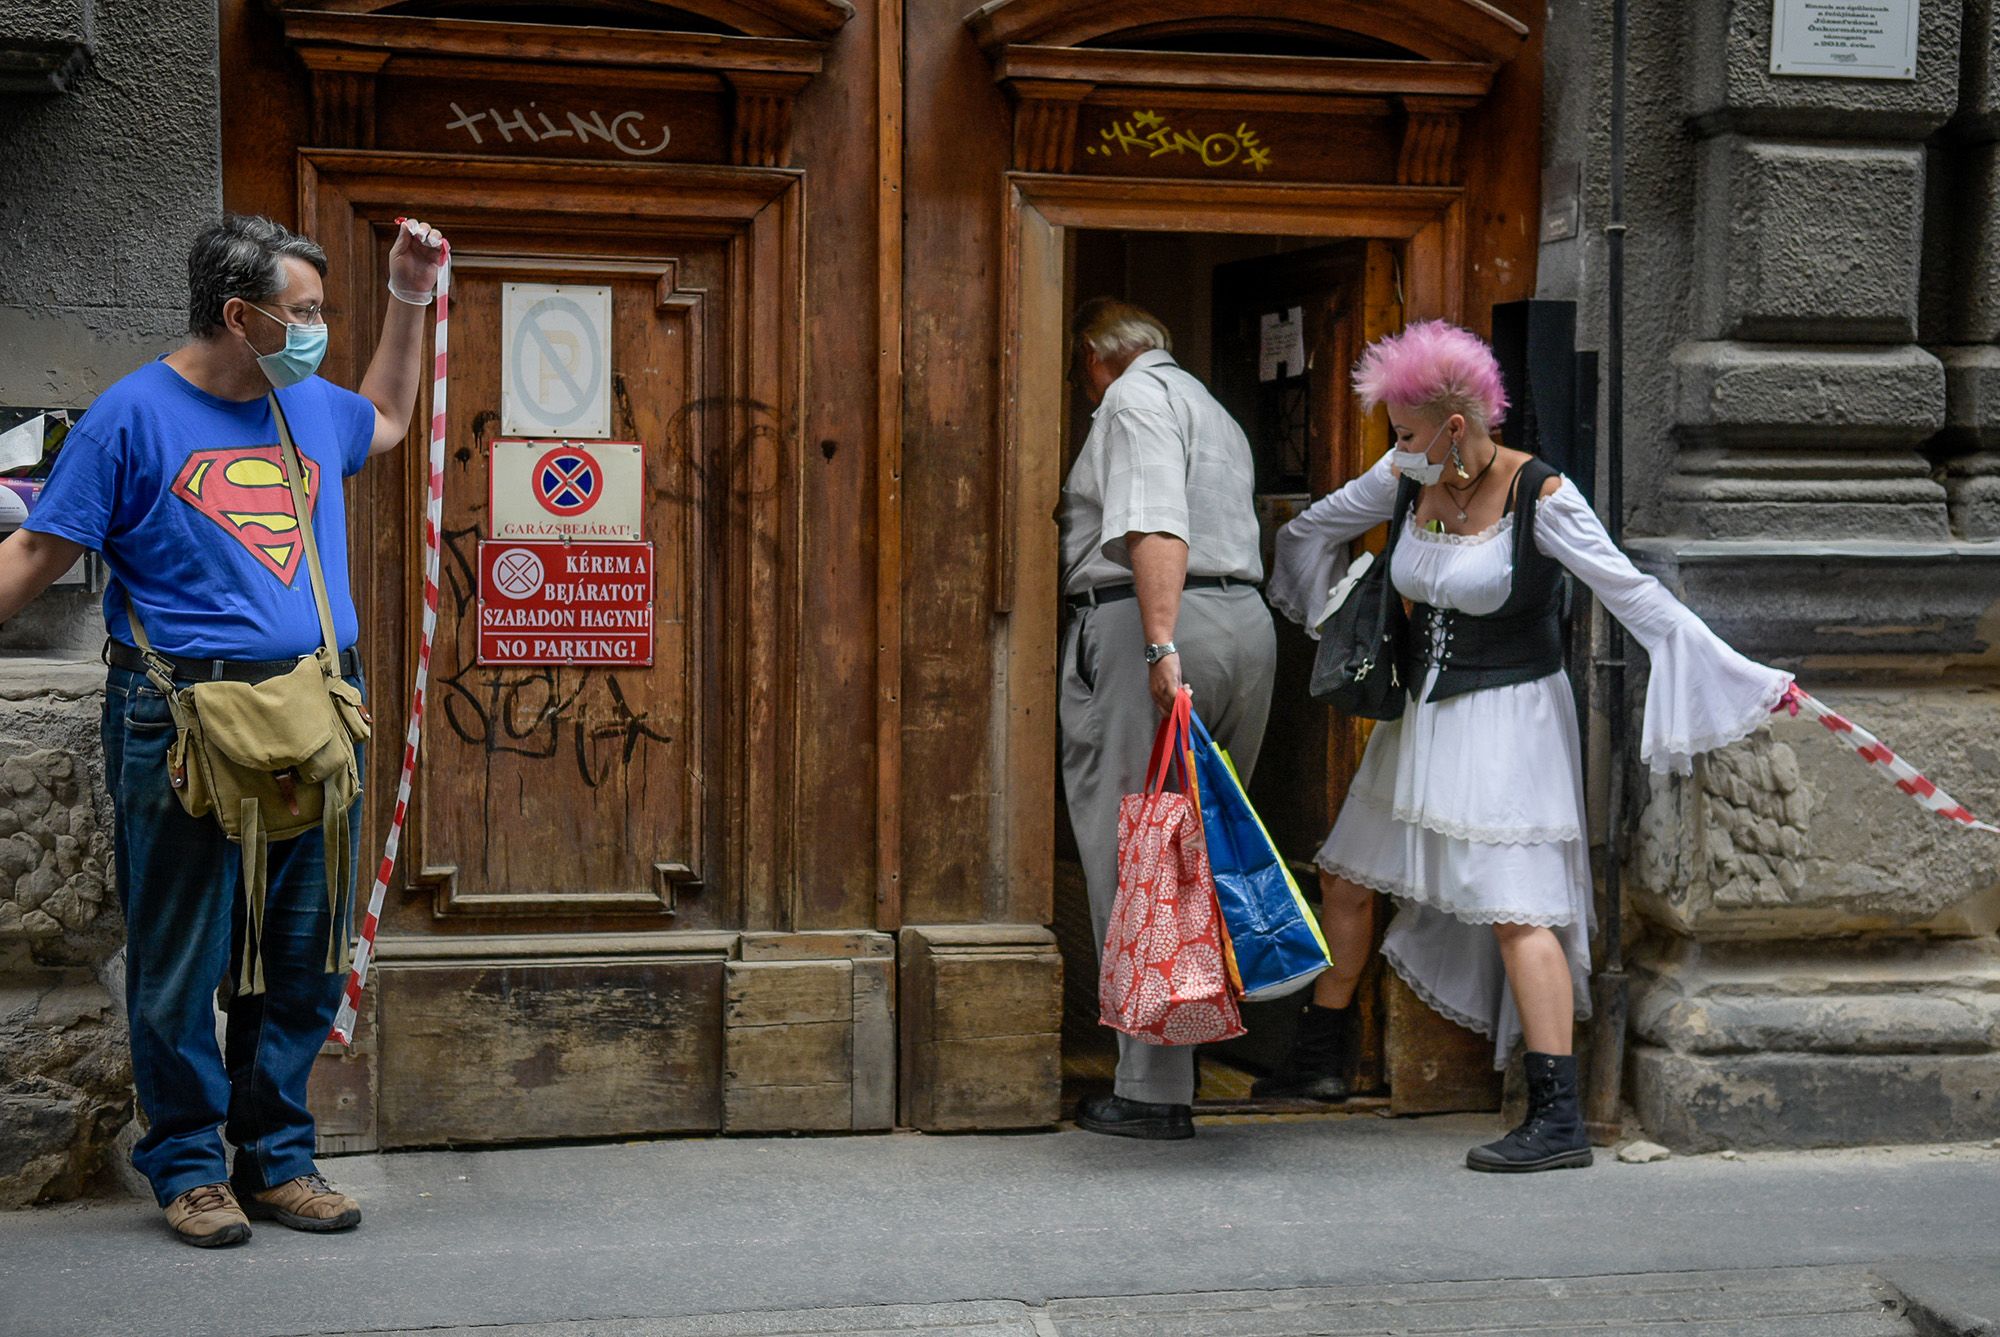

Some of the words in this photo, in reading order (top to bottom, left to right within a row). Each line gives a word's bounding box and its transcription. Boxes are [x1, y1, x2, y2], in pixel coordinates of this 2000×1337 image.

[504, 521, 631, 536] GARÁZSBEJÁRAT!
[566, 551, 631, 574] KÉREM
[634, 556, 647, 574] A
[544, 578, 646, 605] BEJÁRATOT
[483, 608, 575, 628] SZABADON
[580, 609, 650, 628] HAGYNI!
[496, 639, 527, 658] NO
[534, 639, 636, 658] PARKING!
